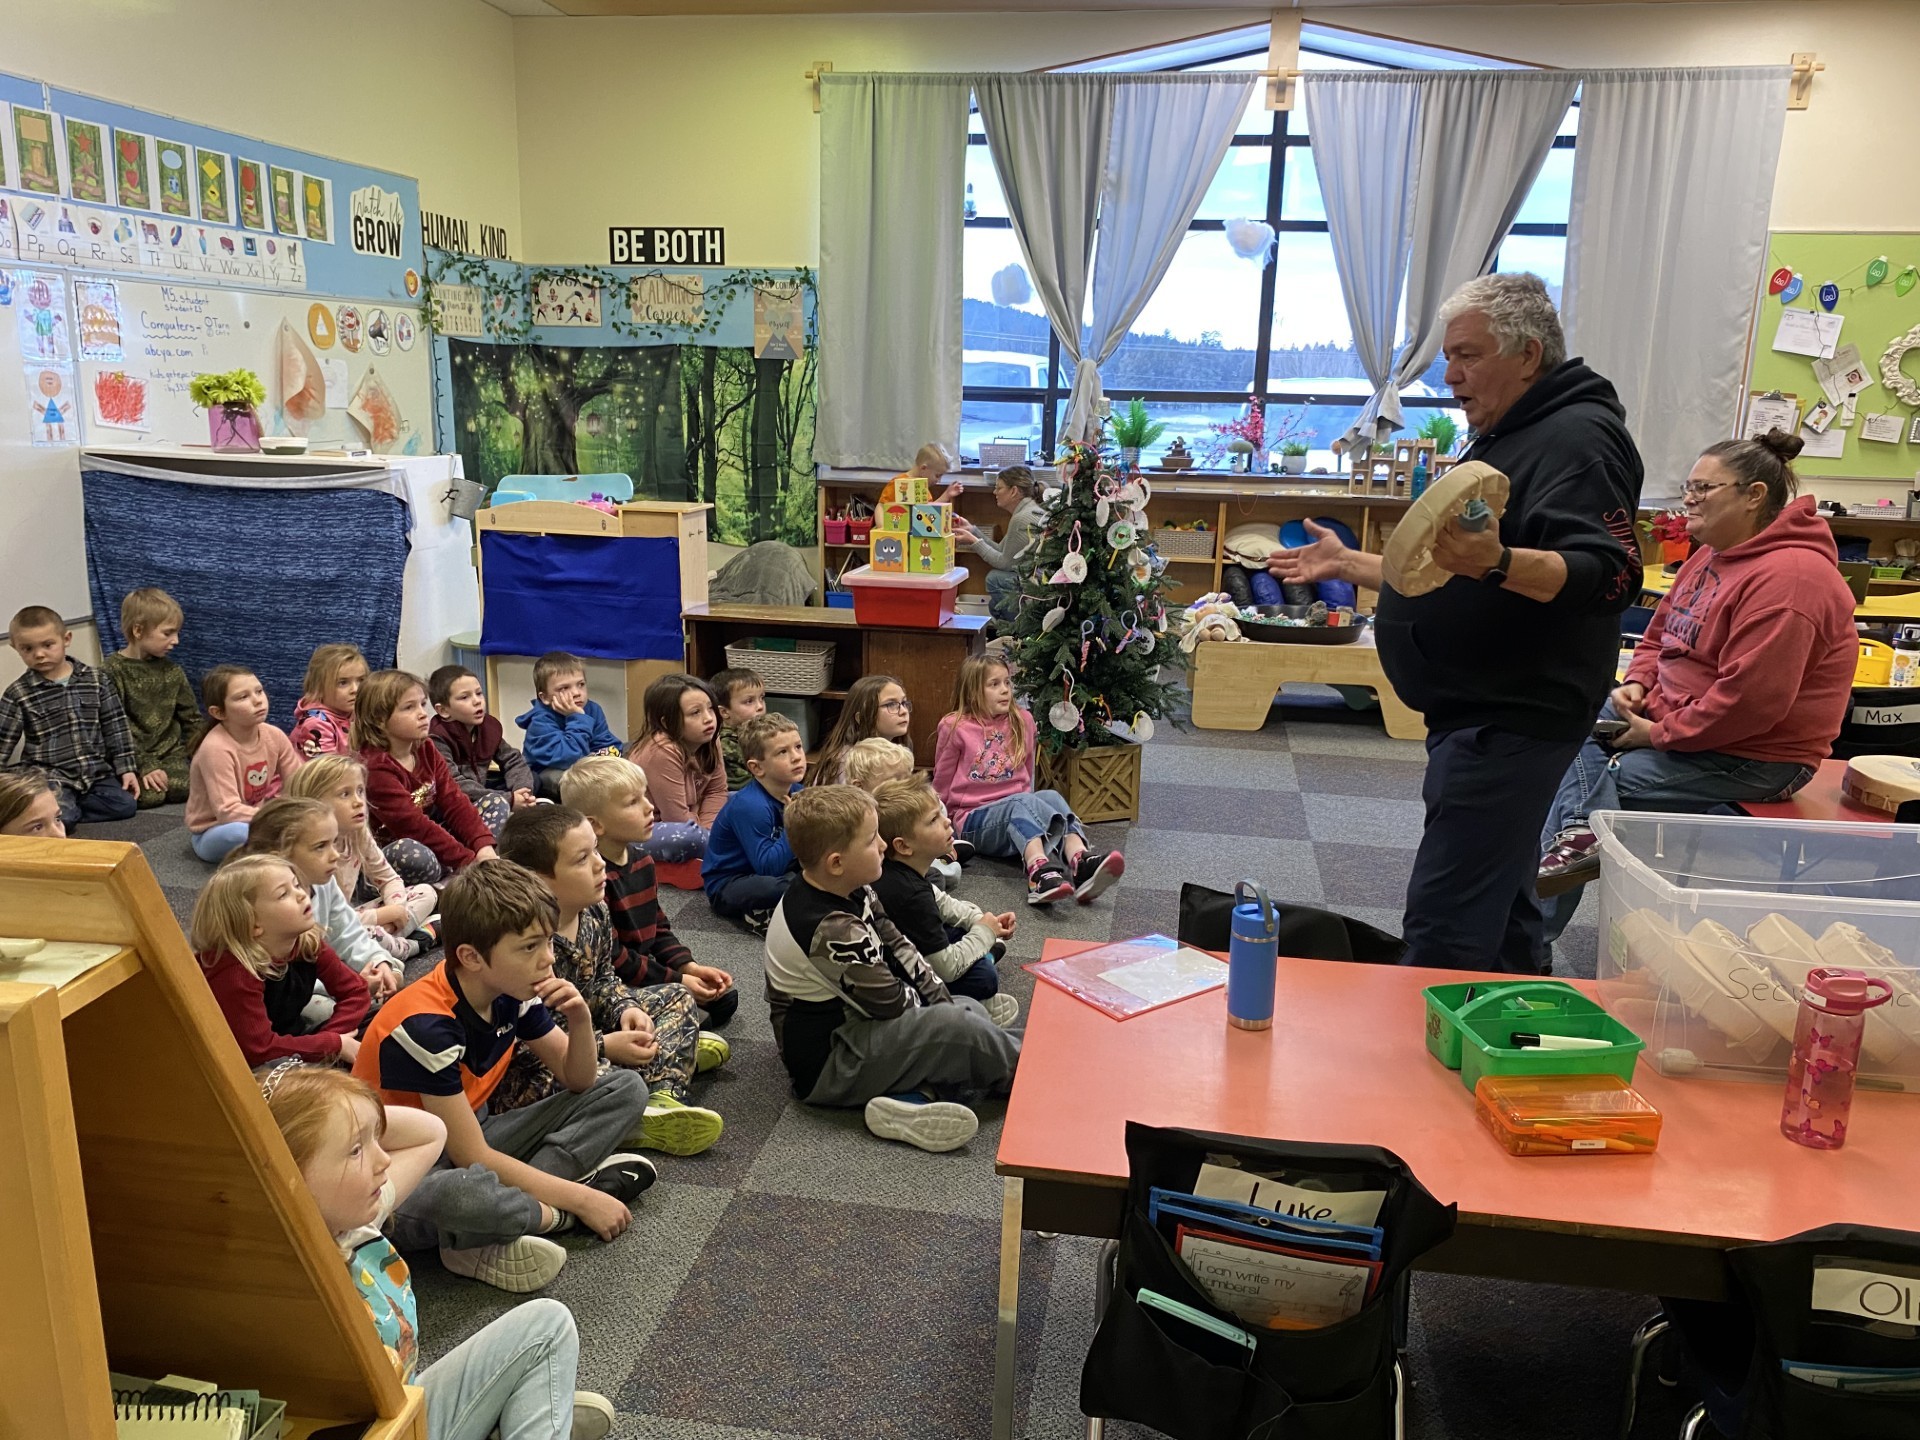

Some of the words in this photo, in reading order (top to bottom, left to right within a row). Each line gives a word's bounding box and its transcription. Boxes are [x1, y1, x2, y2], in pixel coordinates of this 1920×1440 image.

[353, 187, 384, 218] Watch
[353, 215, 401, 257] GROW
[613, 229, 646, 262] BE
[654, 229, 721, 263] BOTH
[27, 234, 45, 259] Pp
[57, 239, 78, 264] Qq
[91, 243, 106, 260] Rr
[120, 246, 134, 264] Ss
[147, 250, 161, 267] Tt
[172, 253, 188, 270] Uu
[200, 257, 212, 272] Vv
[219, 260, 240, 275] Ww
[246, 263, 260, 278] Xx
[269, 265, 280, 285] Yy
[291, 268, 302, 283] Zz
[638, 280, 695, 306] CALMING
[646, 305, 688, 321] Corner
[1865, 710, 1903, 724] Max
[497, 1022, 514, 1037] FILA
[1198, 1260, 1203, 1271] I
[1206, 1265, 1232, 1278] can
[1235, 1271, 1270, 1285] write
[1274, 1278, 1296, 1290] my
